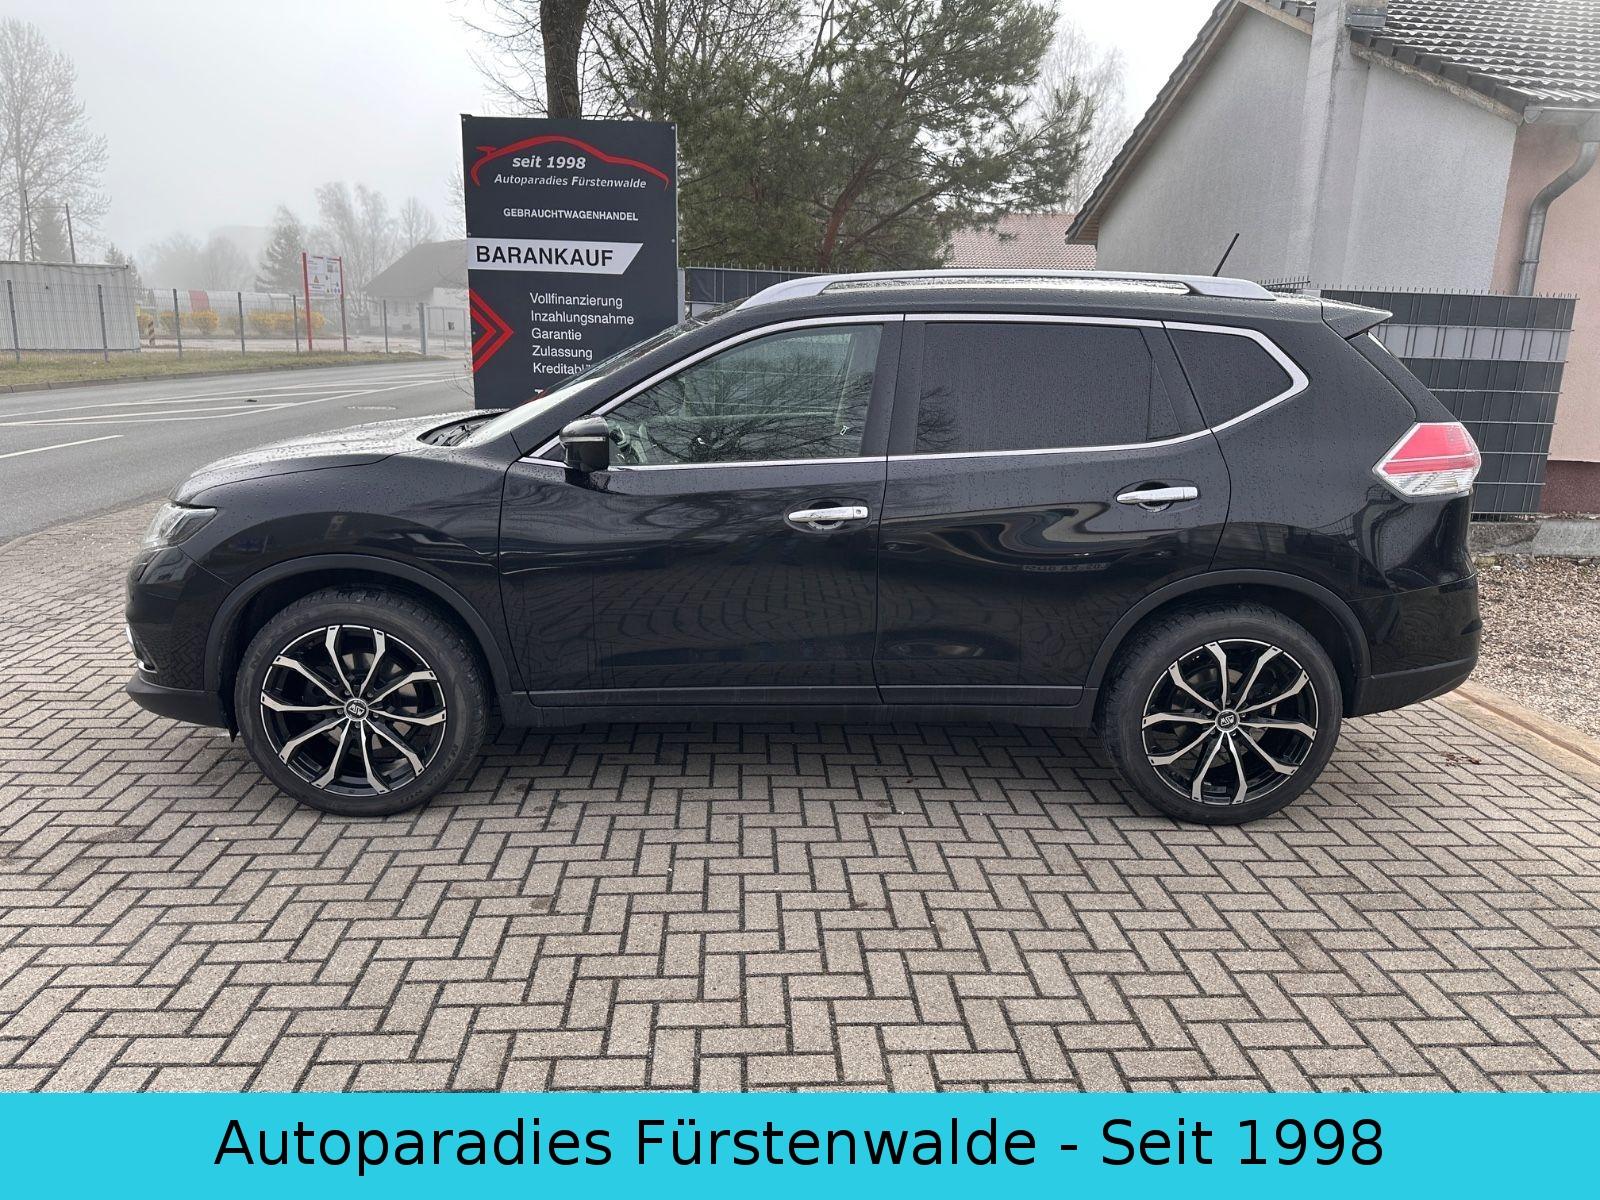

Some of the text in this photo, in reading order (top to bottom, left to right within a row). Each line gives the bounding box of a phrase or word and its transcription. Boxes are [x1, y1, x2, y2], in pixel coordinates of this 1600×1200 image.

[512, 155, 586, 169] seit 1998
[494, 173, 647, 189] Autoparadies Fürstenwalde
[503, 207, 639, 221] GEBRAUCHTWAGENHANDEL
[475, 245, 614, 267] BARANKAUF
[529, 292, 623, 309] Vollfinanzierung
[531, 310, 635, 326] Inzahlungsnahme
[531, 327, 582, 341] Garantie
[532, 344, 593, 360] Zulassung
